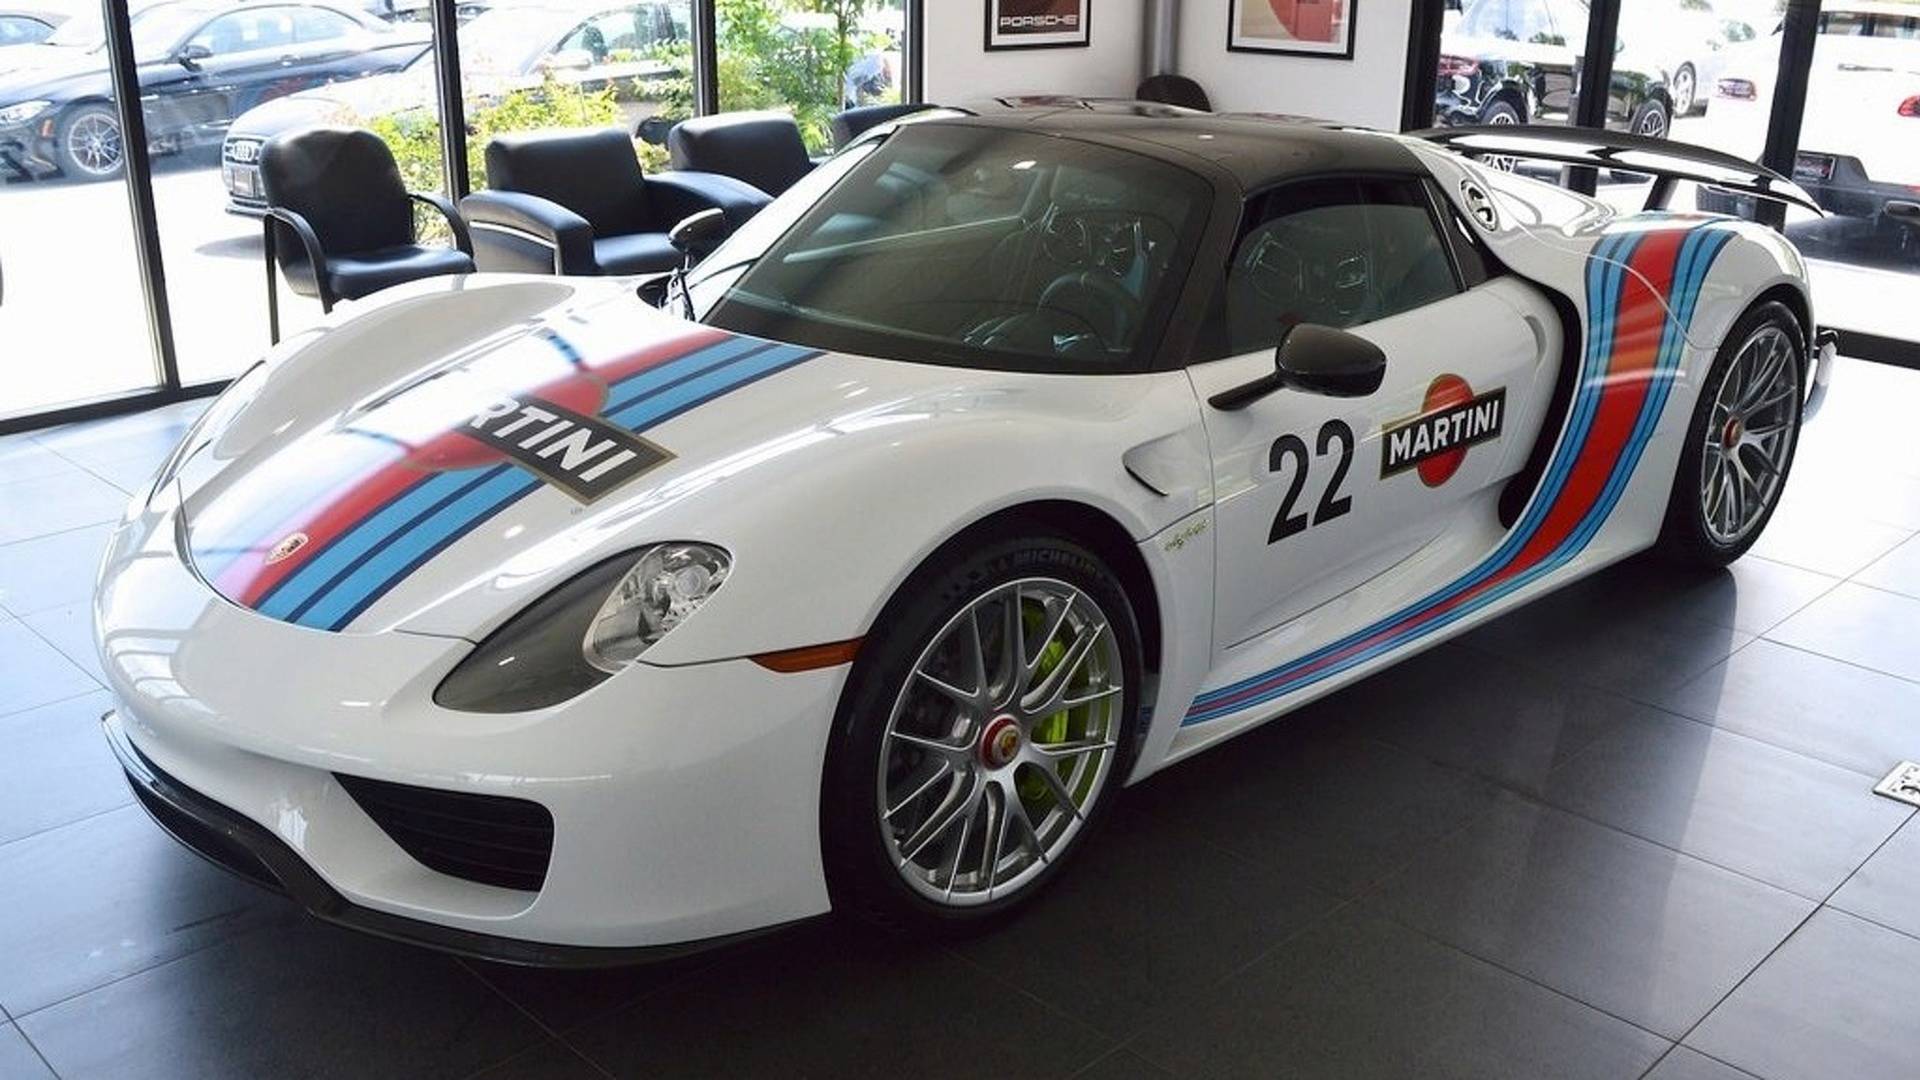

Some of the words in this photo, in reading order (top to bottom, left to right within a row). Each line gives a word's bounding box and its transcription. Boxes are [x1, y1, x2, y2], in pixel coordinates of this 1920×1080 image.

[1000, 14, 1078, 27] PORSCHE
[470, 398, 637, 482] RTINI
[1389, 399, 1499, 466] MARTINI
[1267, 418, 1355, 545] 22
